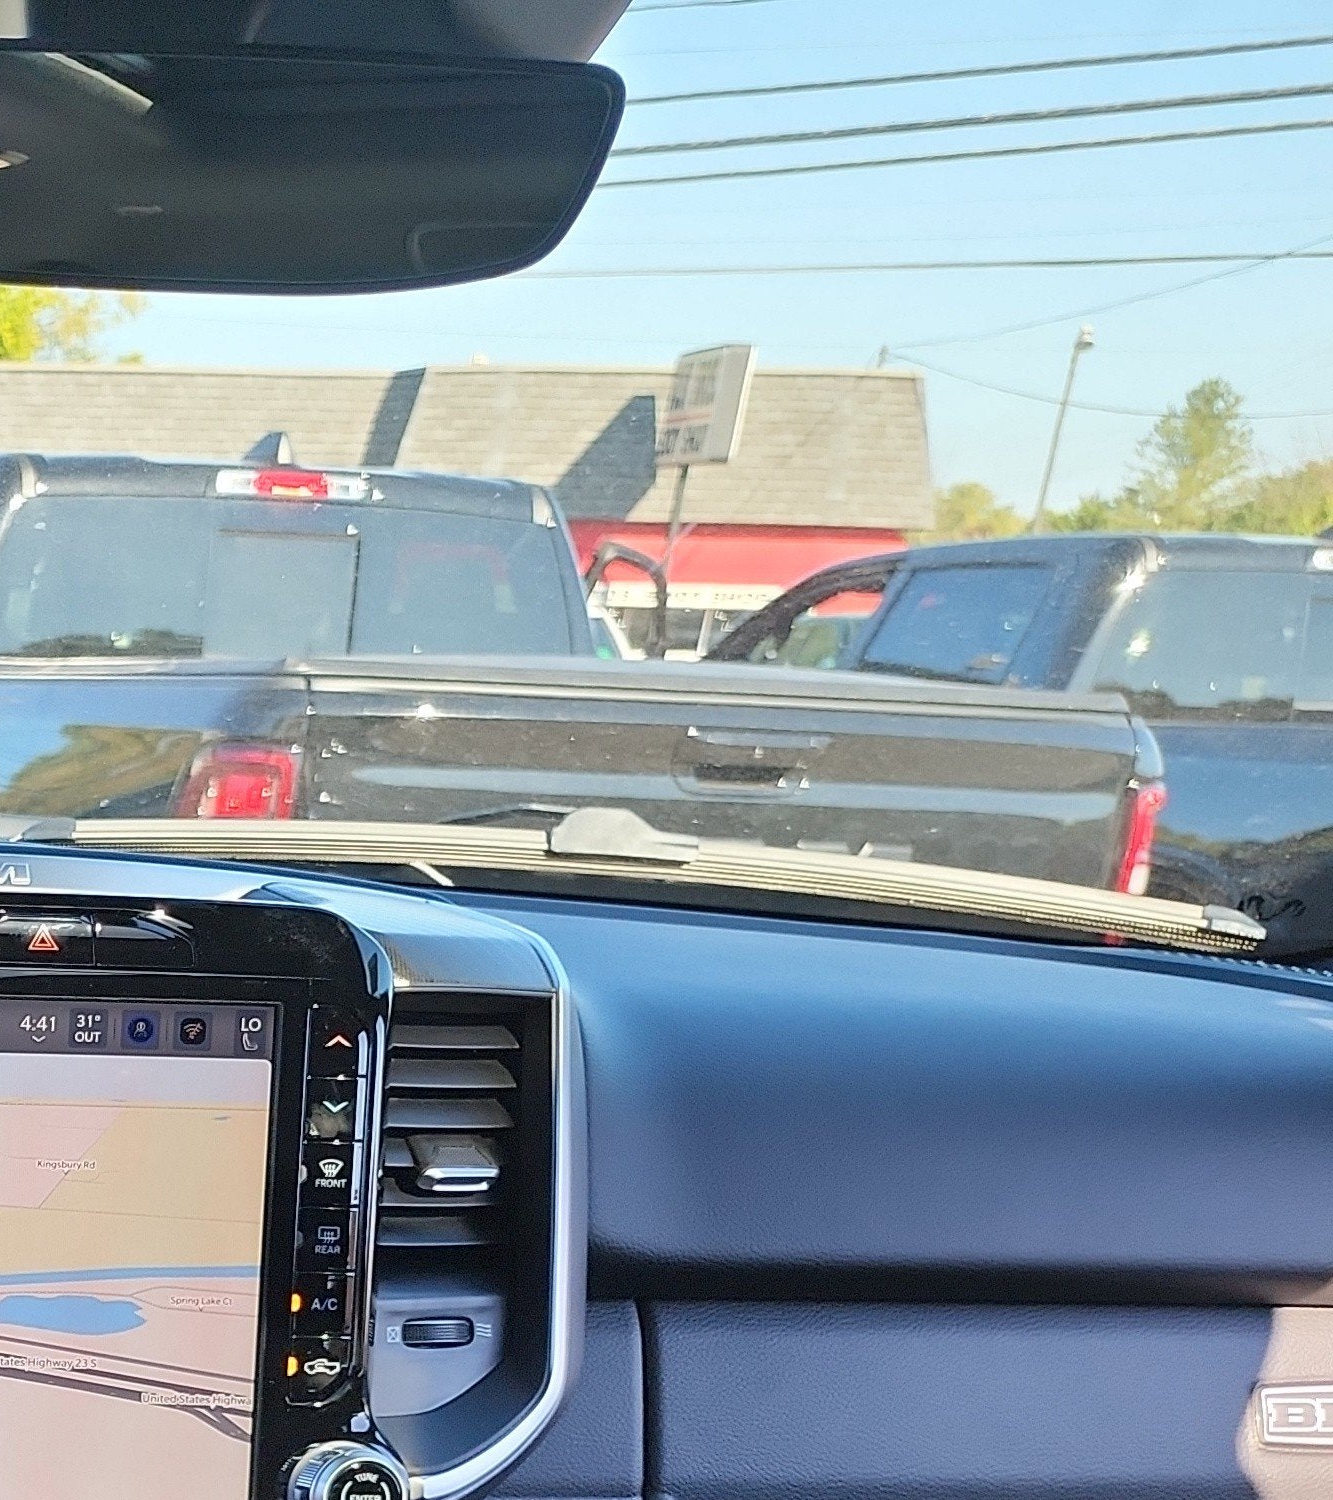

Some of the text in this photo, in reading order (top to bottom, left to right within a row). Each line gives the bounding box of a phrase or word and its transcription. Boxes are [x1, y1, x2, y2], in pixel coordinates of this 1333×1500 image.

[19, 1014, 57, 1033] 4:41
[240, 1017, 262, 1033] LO
[74, 1031, 102, 1044] OUT
[37, 1159, 96, 1171] Kingsbury Rd
[314, 1179, 347, 1189] FRONT
[314, 1245, 341, 1255] REAR
[170, 1296, 199, 1308] Spring
[201, 1297, 221, 1306] Lake
[311, 1297, 338, 1311] A/C
[28, 1357, 74, 1371] Highway
[75, 1358, 89, 1369] 23
[91, 1359, 97, 1369] S
[142, 1393, 178, 1405] United
[179, 1394, 210, 1405] States
[354, 1472, 379, 1483] TUNE
